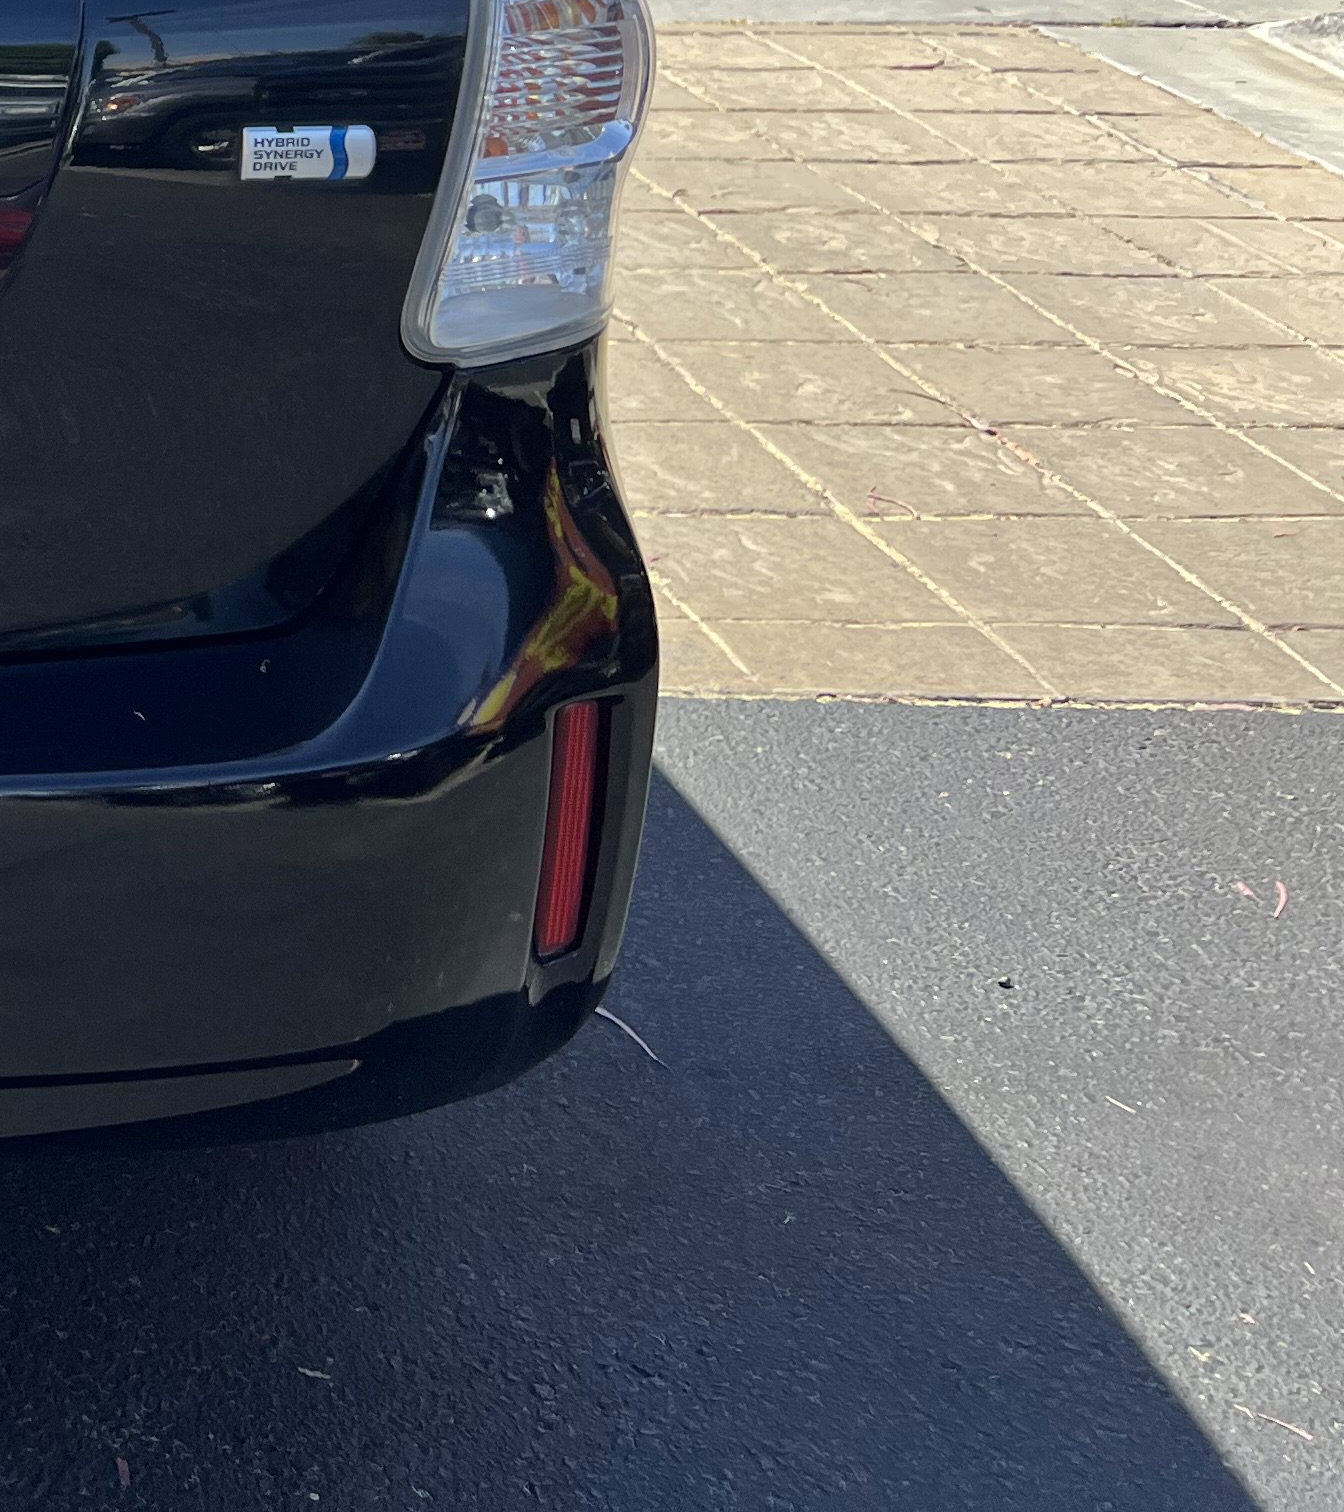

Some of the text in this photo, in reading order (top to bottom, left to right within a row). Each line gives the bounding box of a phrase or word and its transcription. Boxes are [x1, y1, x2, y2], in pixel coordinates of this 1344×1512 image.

[254, 137, 311, 148] HYBRID
[253, 149, 324, 160] SYNERGY
[252, 161, 299, 172] DRIVE
